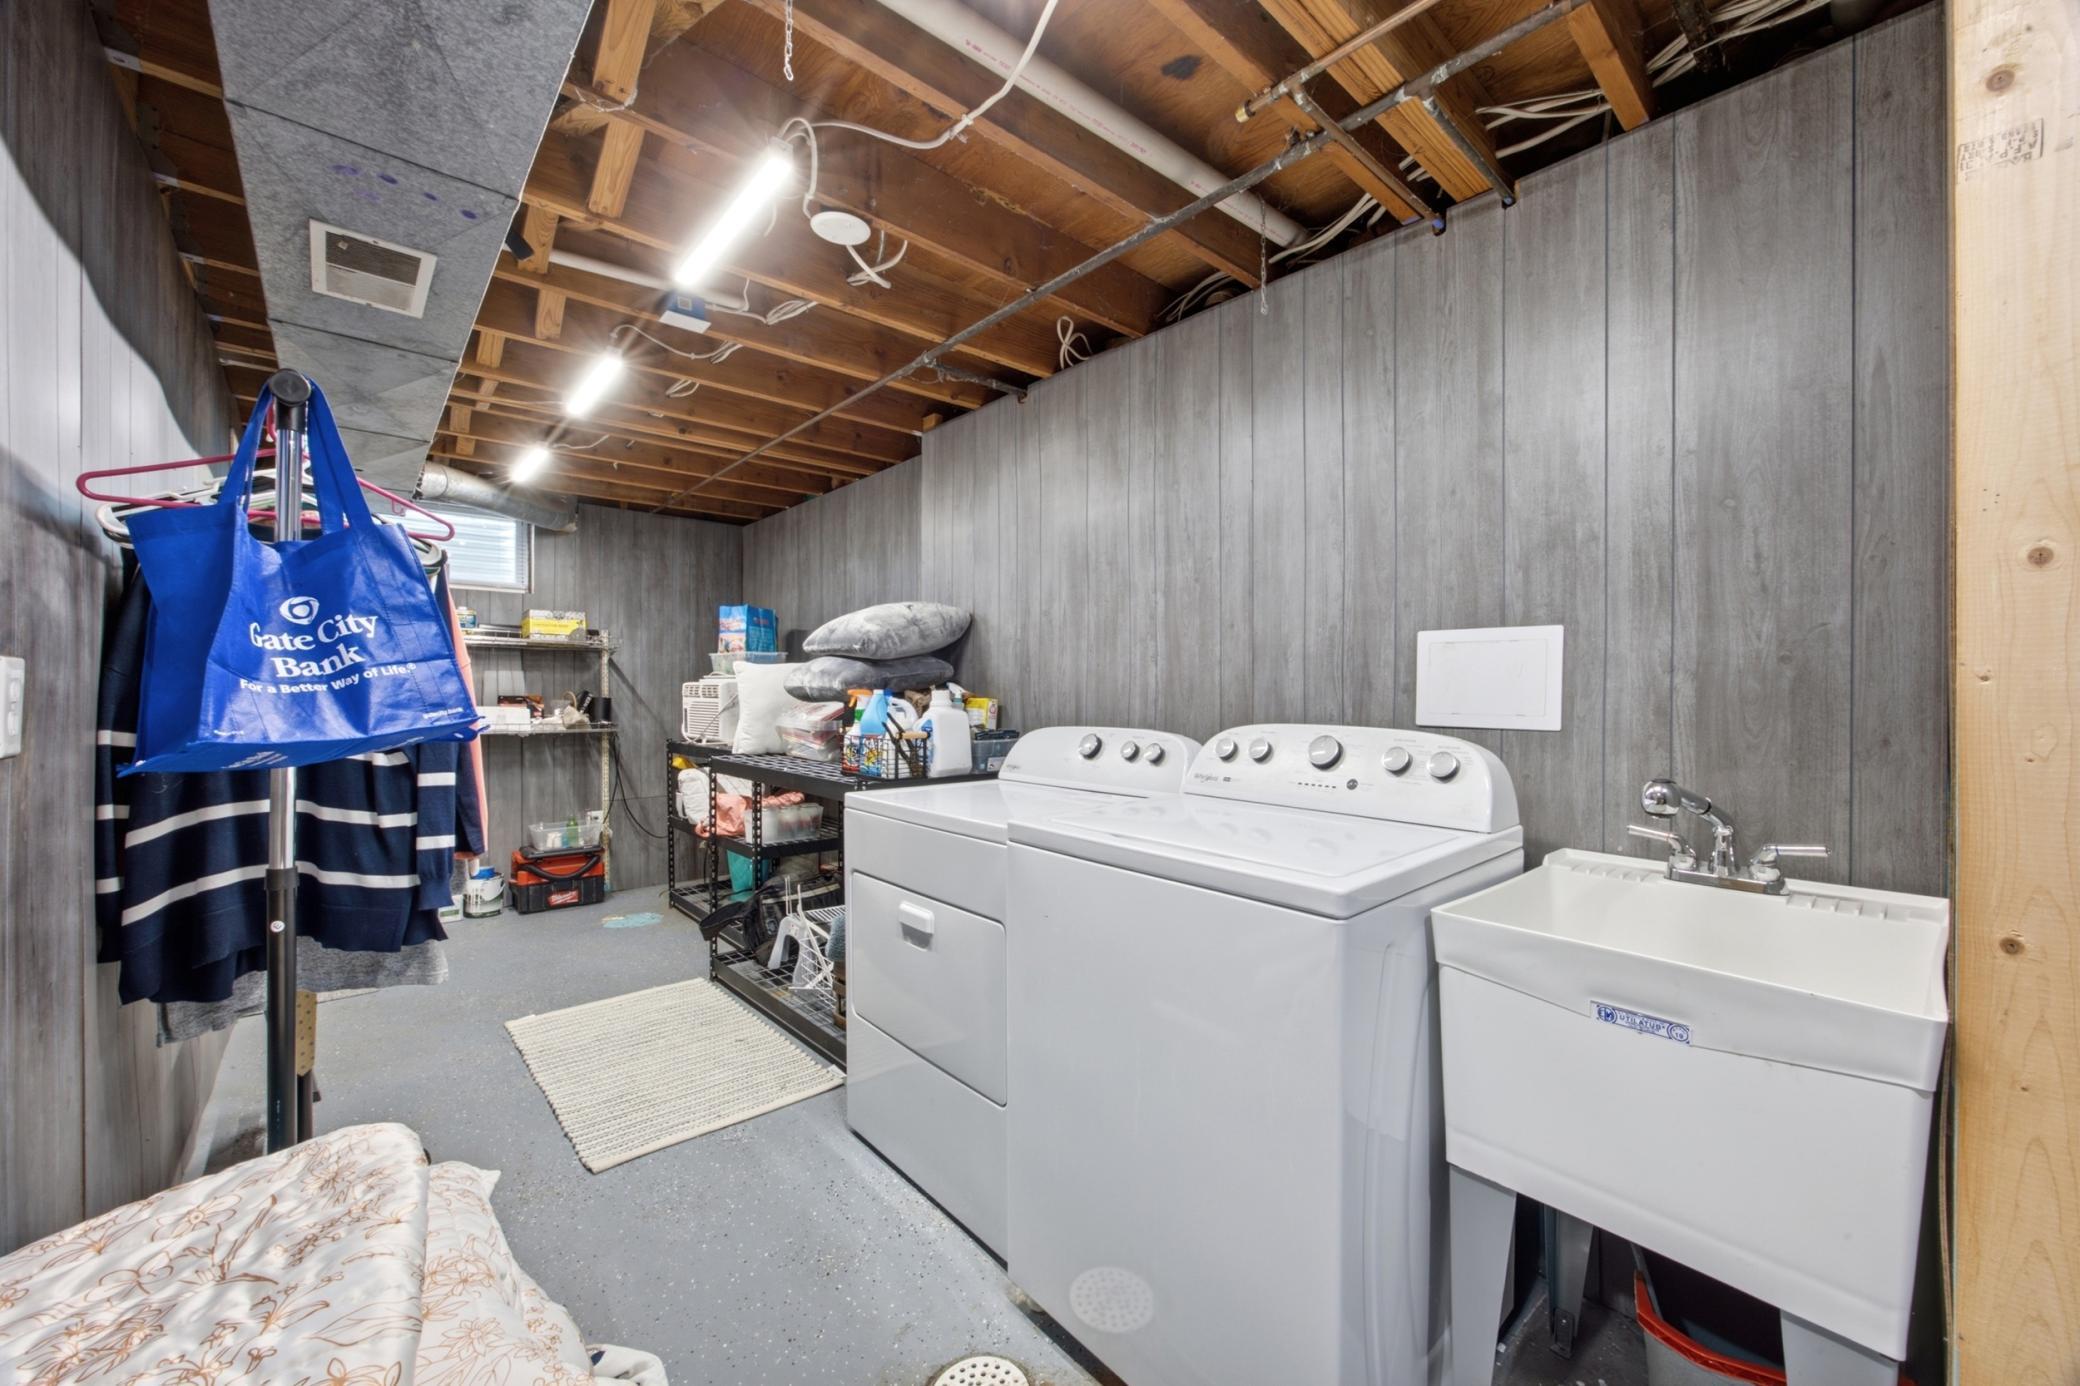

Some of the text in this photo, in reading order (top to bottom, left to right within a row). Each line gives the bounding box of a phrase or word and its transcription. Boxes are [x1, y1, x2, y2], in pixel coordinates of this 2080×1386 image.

[250, 614, 379, 651] Gate City
[270, 643, 366, 678] Bank
[240, 678, 264, 694] For
[267, 684, 277, 694] a
[280, 682, 329, 694] Better
[330, 673, 360, 691] Way
[363, 667, 378, 679] of
